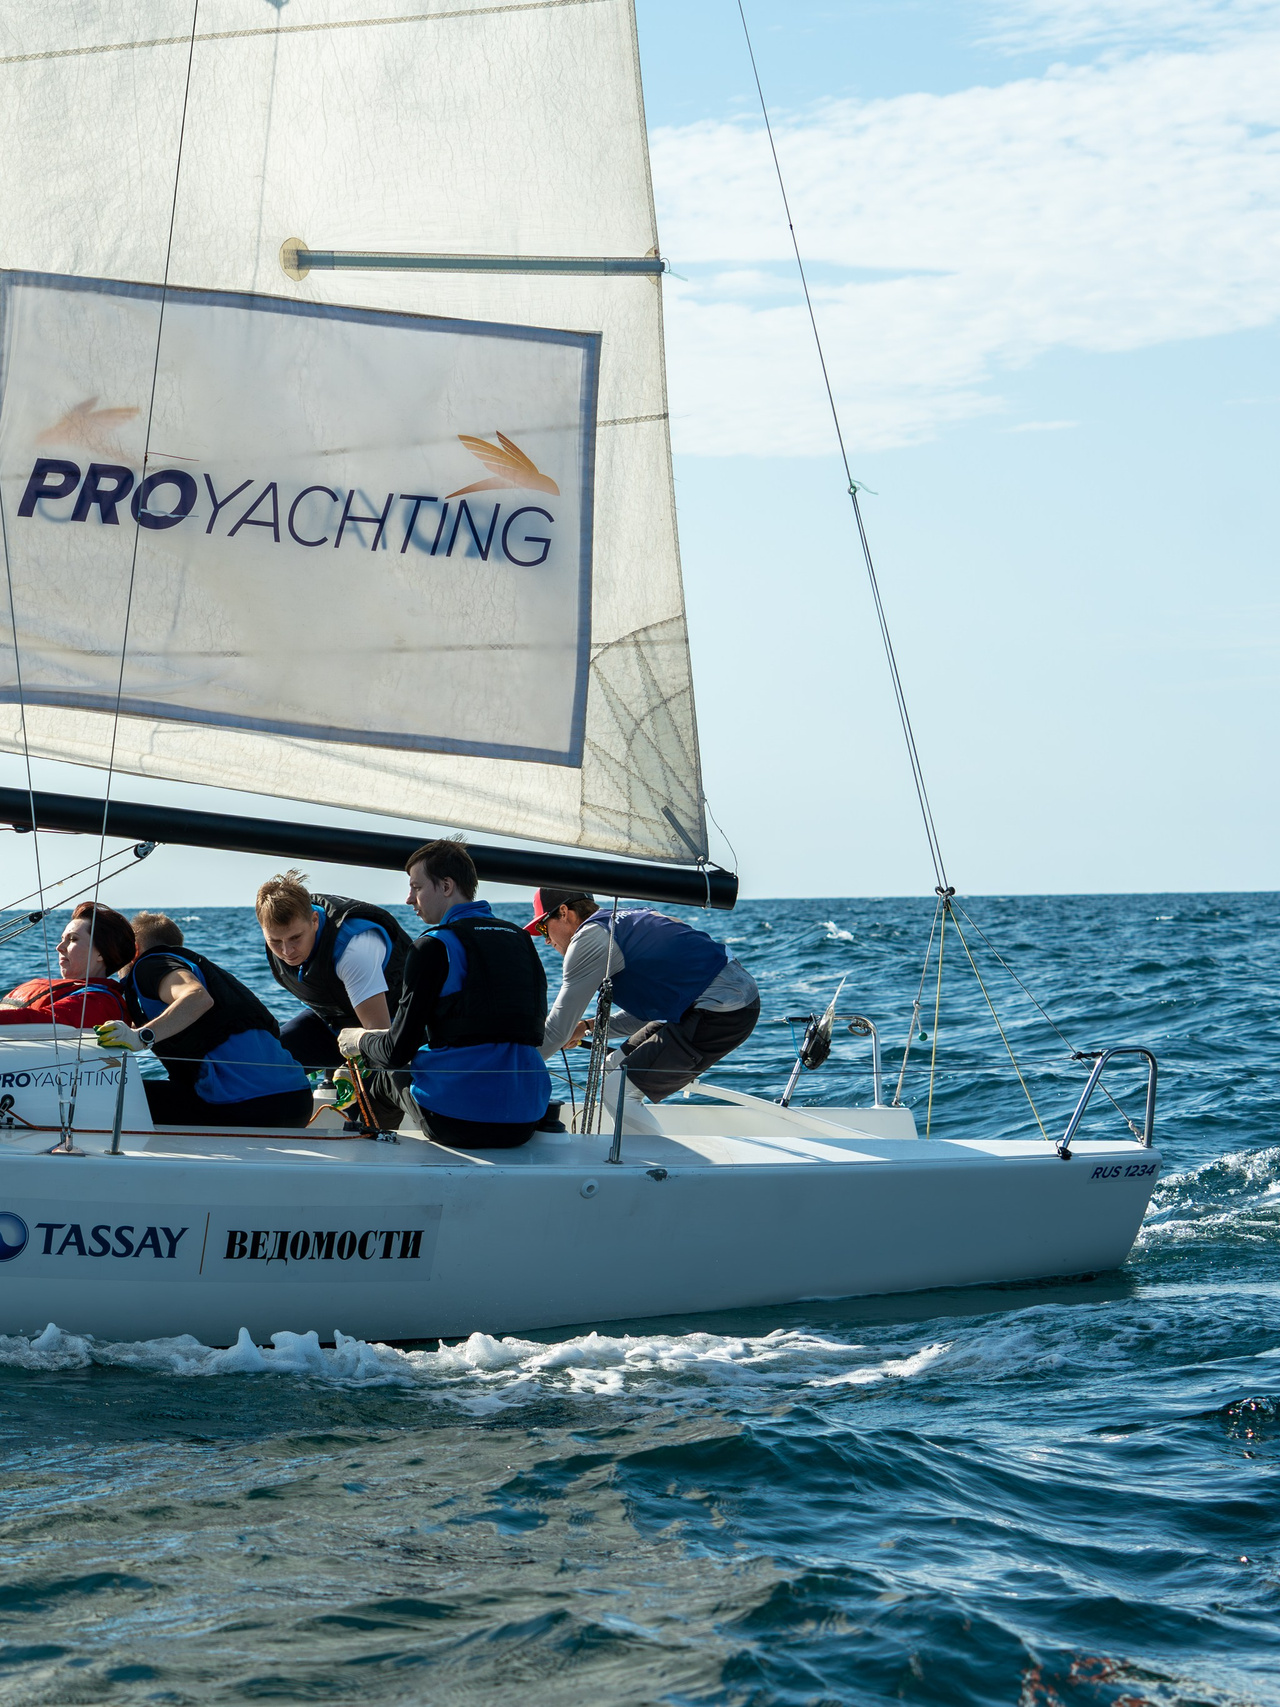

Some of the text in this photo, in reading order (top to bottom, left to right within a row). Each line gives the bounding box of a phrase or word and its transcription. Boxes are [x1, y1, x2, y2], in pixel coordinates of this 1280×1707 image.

[17, 457, 556, 567] PROYACHTING
[1091, 1164, 1157, 1179] RUS 1234
[34, 1222, 189, 1258] TASSAY
[223, 1229, 425, 1265] ВЕДОМОСТИ
